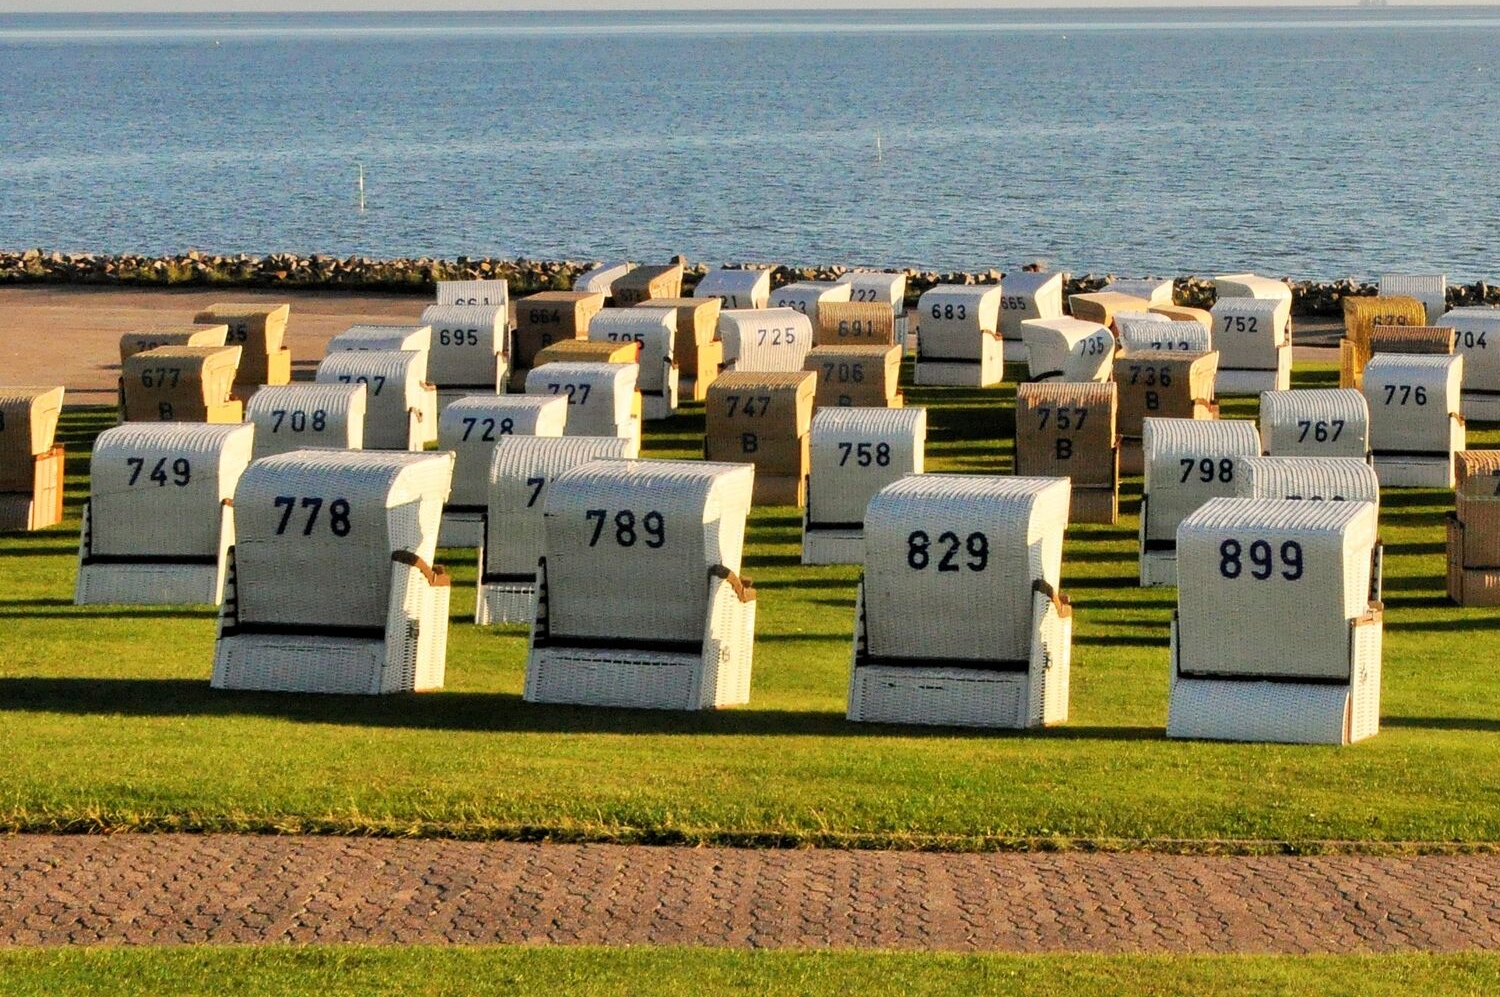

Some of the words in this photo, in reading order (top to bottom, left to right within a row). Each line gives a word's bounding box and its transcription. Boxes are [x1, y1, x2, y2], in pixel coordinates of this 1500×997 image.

[932, 304, 966, 320] 683
[1000, 297, 1026, 309] 665
[838, 320, 873, 337] 691
[1223, 317, 1257, 332] 752
[440, 329, 478, 346] 695
[758, 328, 794, 346] 725
[1080, 338, 1104, 357] 735
[142, 368, 180, 388] 677
[824, 363, 863, 383] 706
[1130, 367, 1171, 387] 736
[1147, 391, 1158, 409] B
[1385, 386, 1427, 405] 776
[727, 396, 770, 417] 747
[272, 410, 326, 433] 708
[1038, 409, 1088, 430] 757
[462, 419, 514, 441] 728
[1298, 420, 1344, 442] 767
[743, 433, 756, 453] B
[1056, 440, 1072, 459] B
[839, 442, 890, 467] 758
[127, 458, 190, 486] 749
[1180, 459, 1232, 482] 798
[274, 497, 352, 536] 778
[585, 510, 664, 548] 789
[907, 531, 989, 571] 829
[1220, 540, 1303, 581] 899
